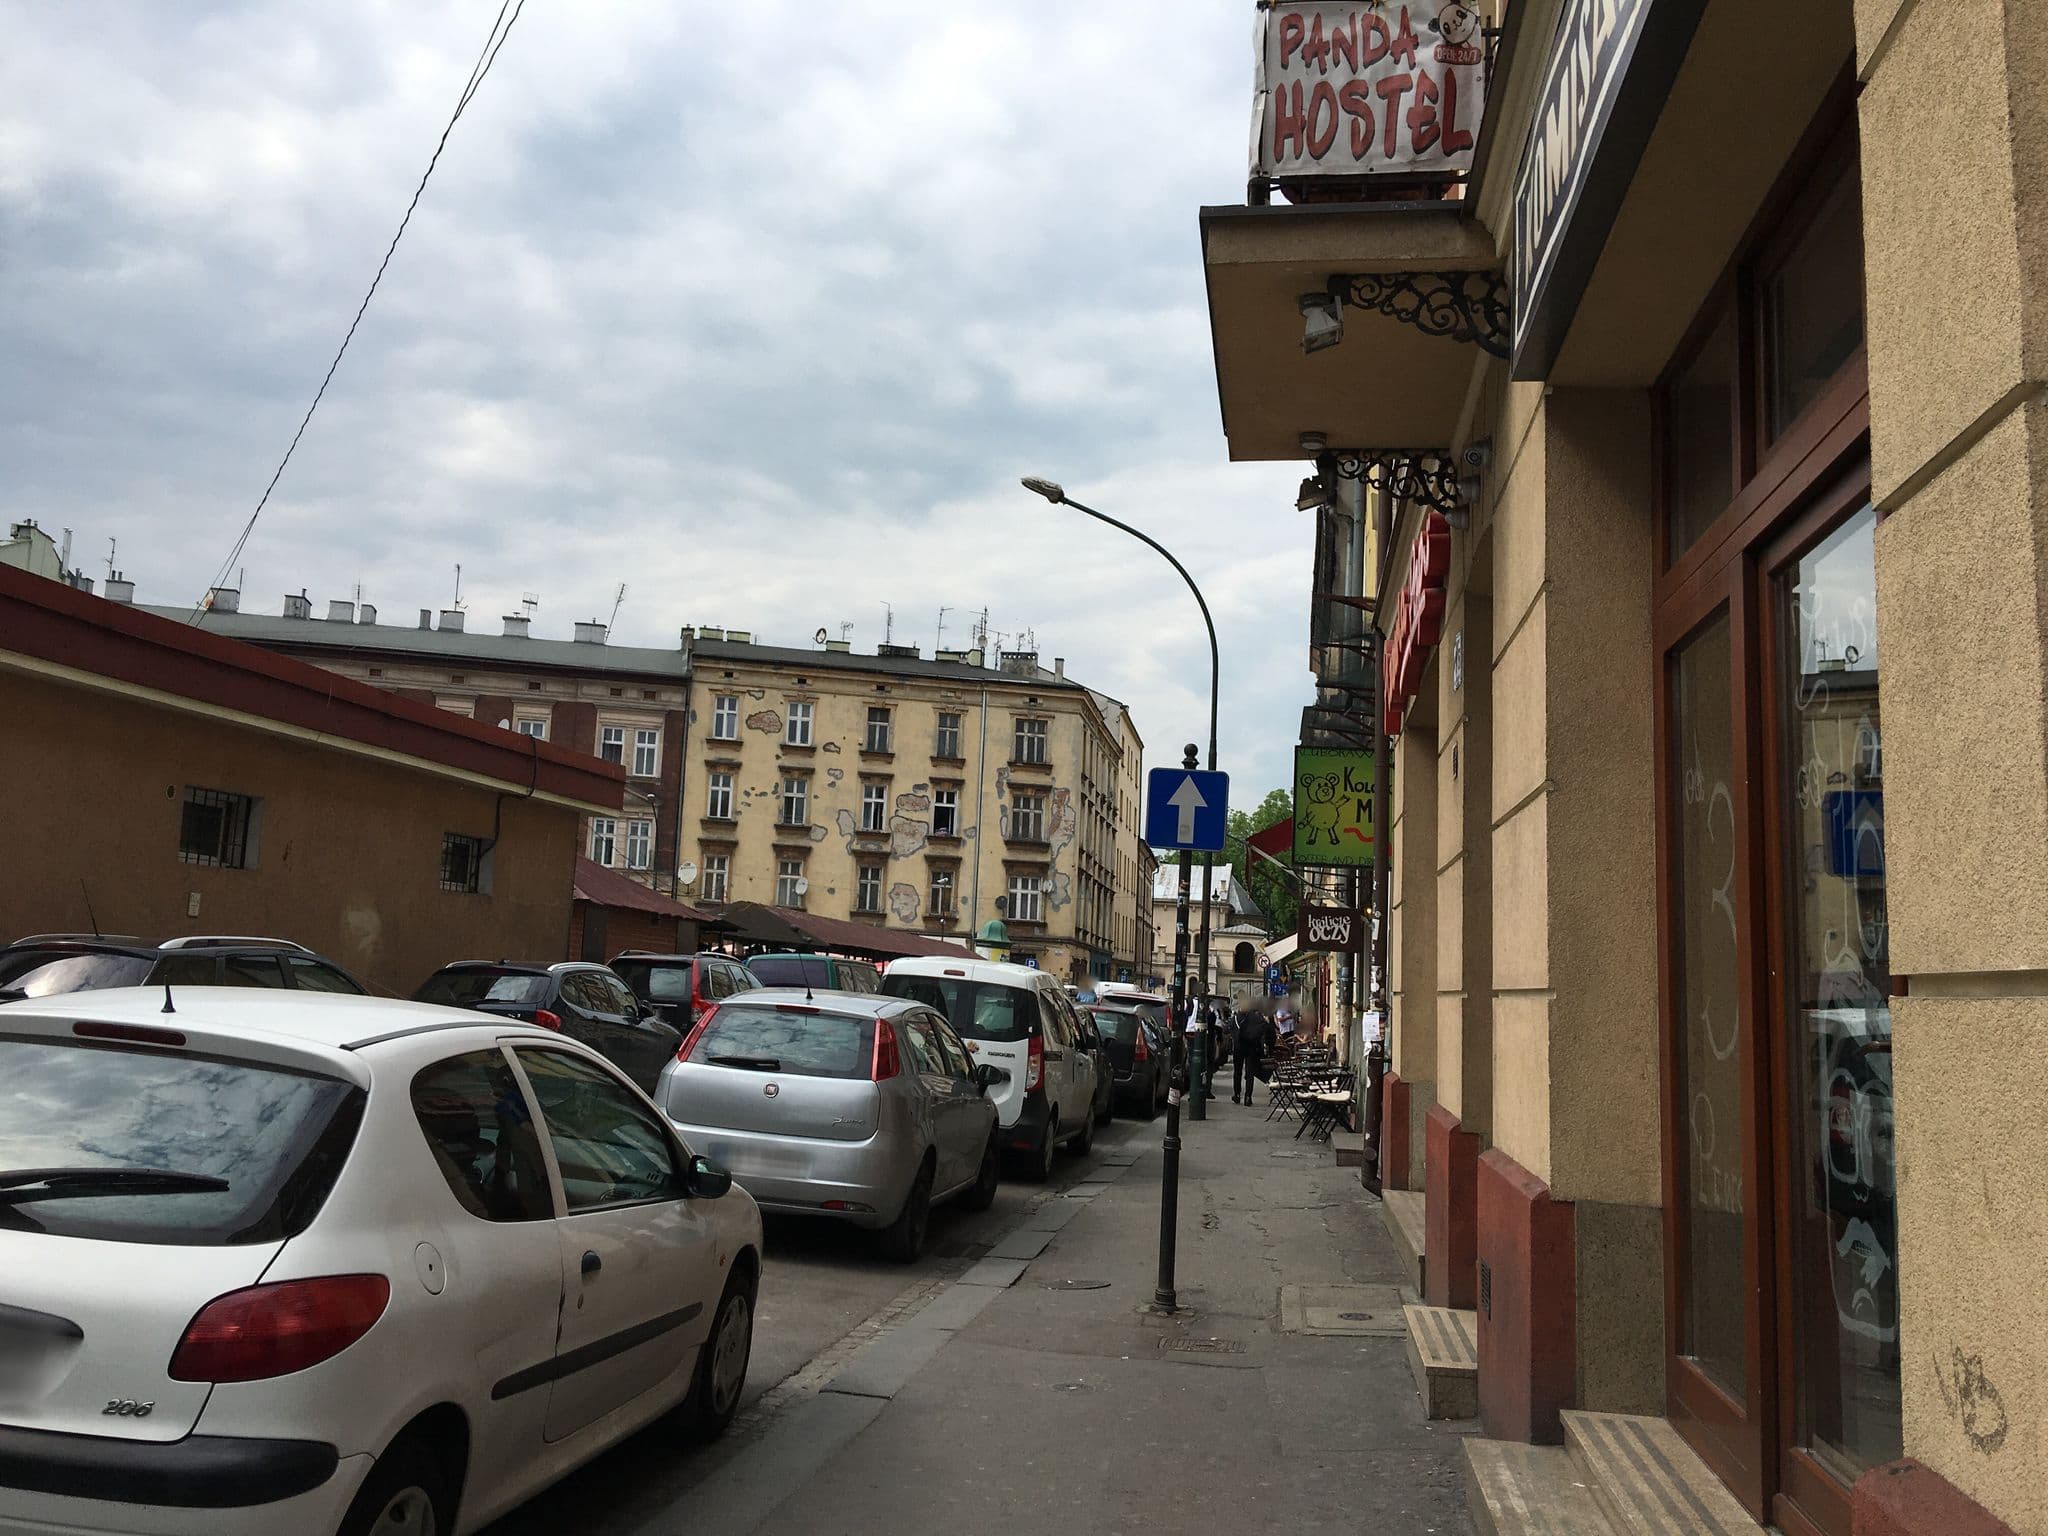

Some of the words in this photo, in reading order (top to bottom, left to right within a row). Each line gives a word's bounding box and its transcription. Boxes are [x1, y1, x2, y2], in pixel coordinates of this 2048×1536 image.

[1280, 5, 1419, 74] PANDA
[1273, 68, 1474, 163] HOSTEL
[1525, 0, 1627, 290] KOMISA
[1356, 799, 1374, 823] M
[102, 1398, 155, 1417] 206
